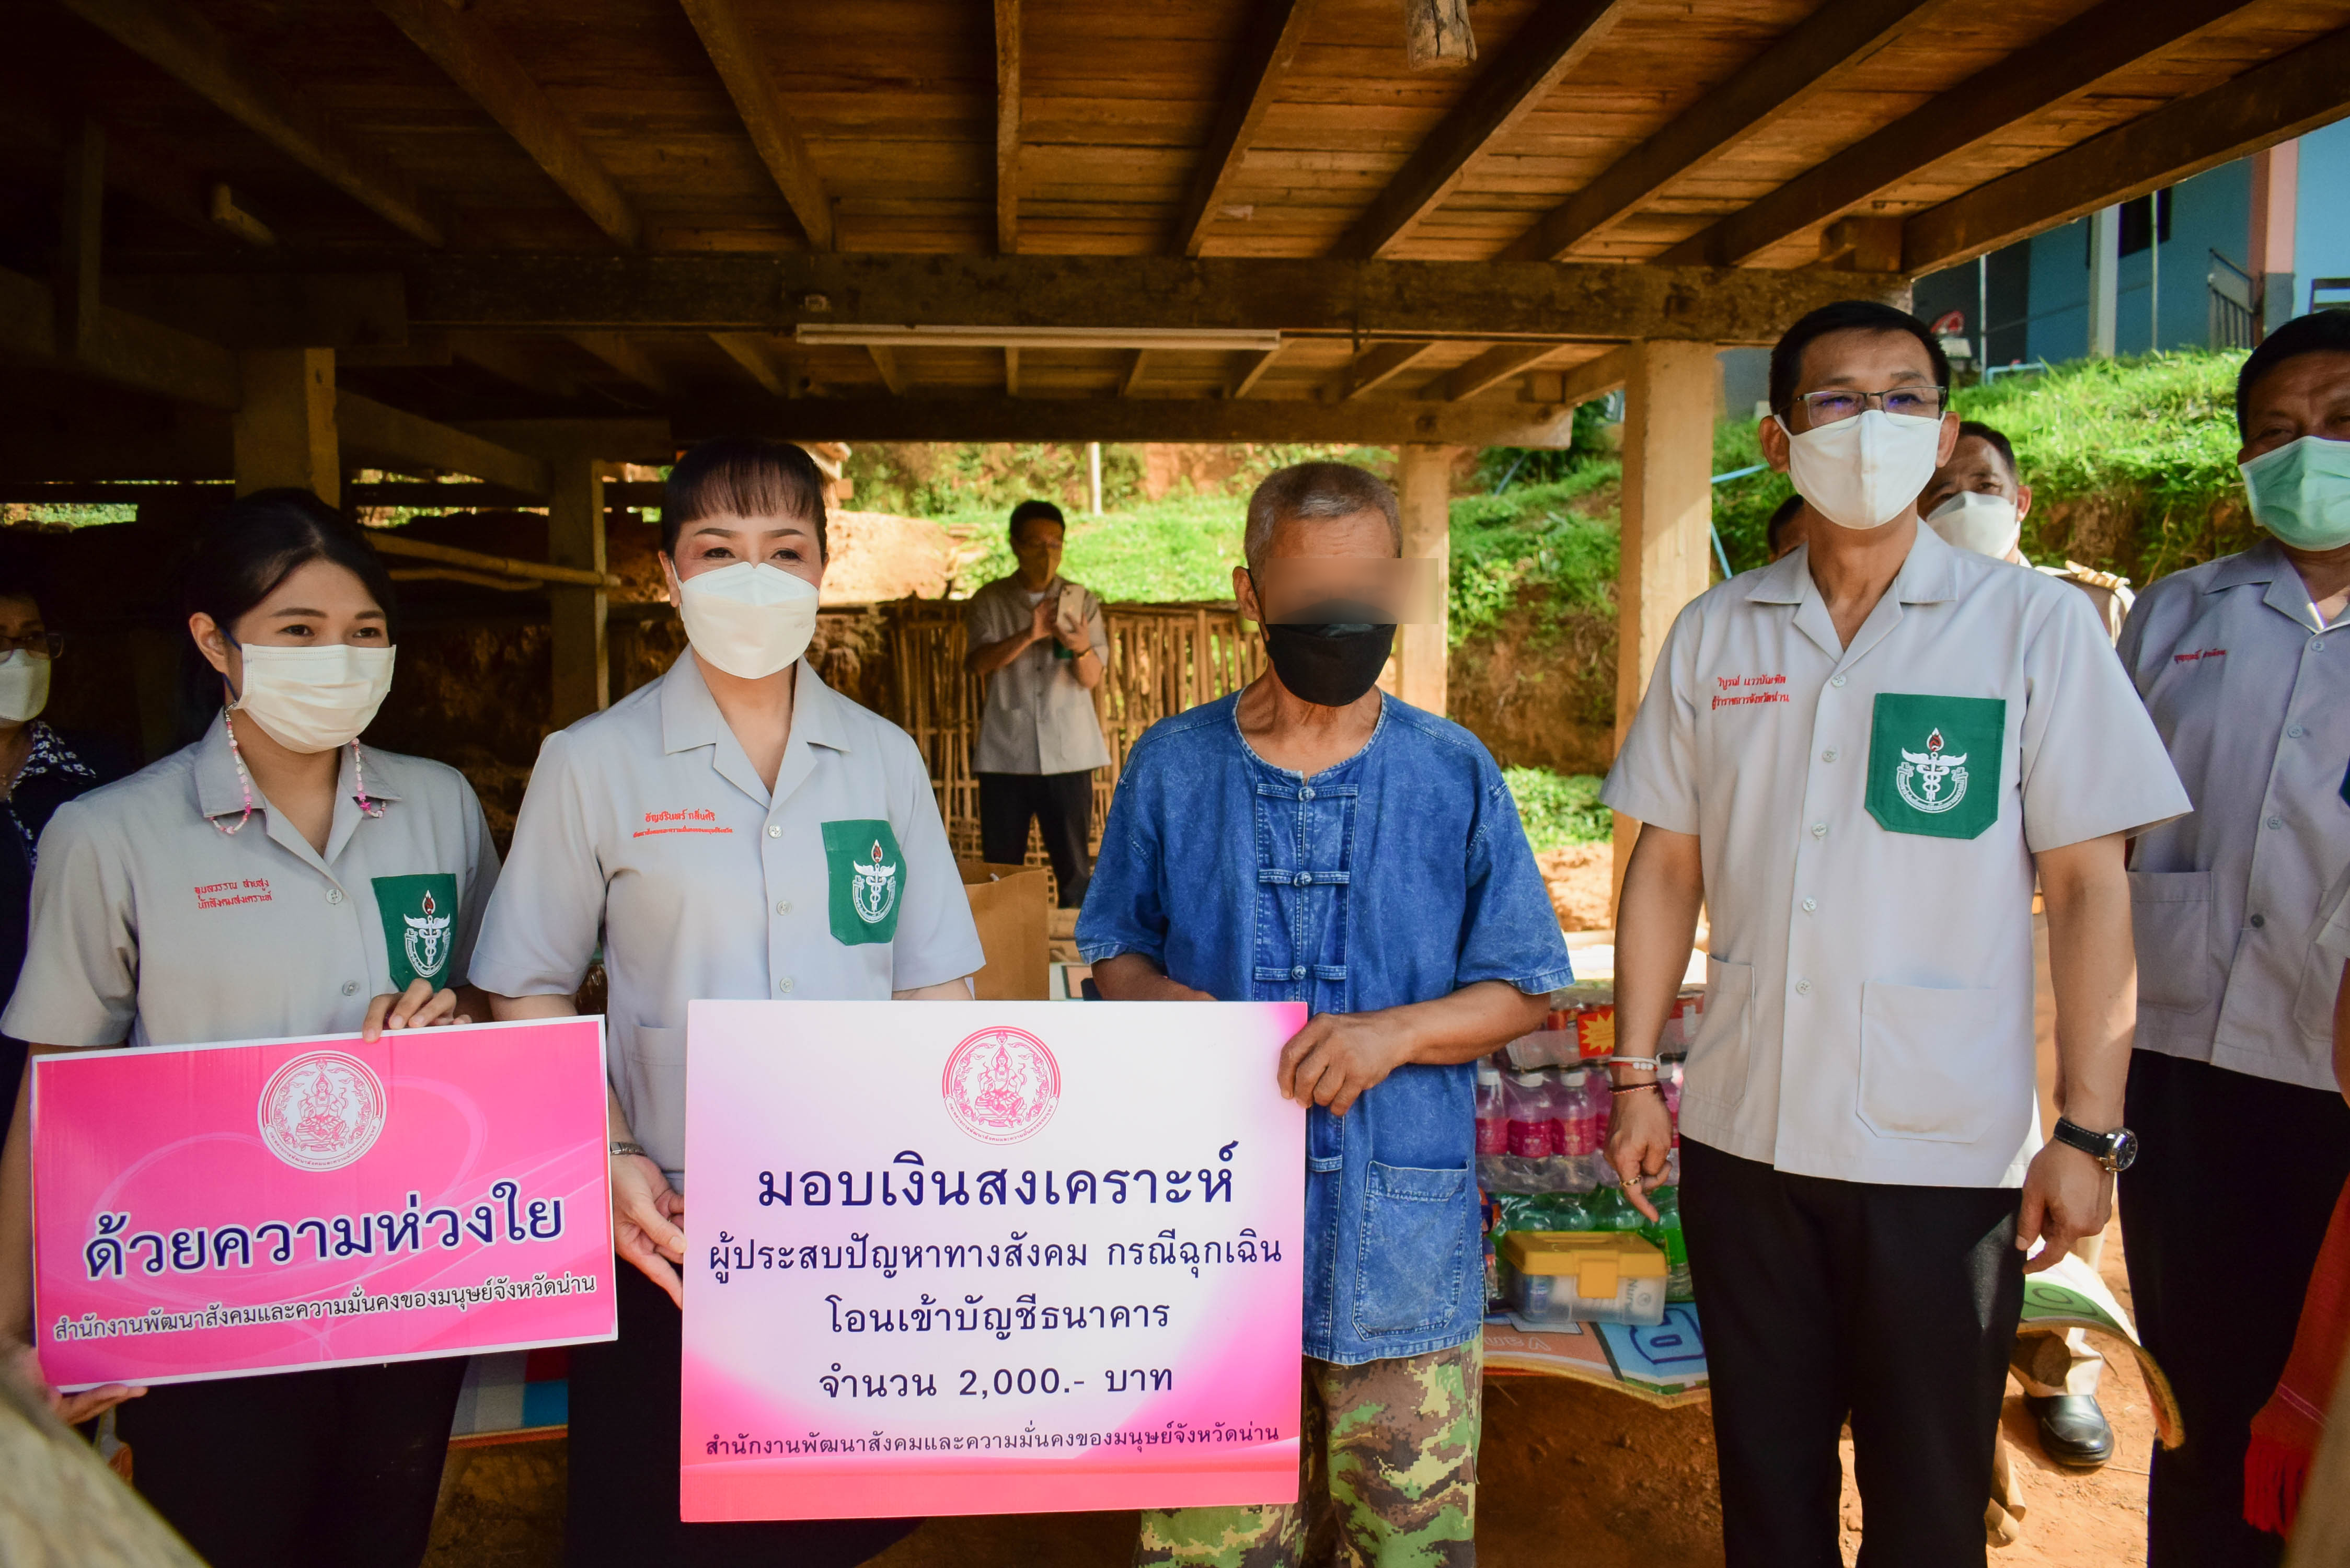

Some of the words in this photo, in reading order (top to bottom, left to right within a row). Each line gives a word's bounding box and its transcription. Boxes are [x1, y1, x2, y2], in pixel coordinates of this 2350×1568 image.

[758, 1140, 1239, 1207] มอบเงินสงเคราะห์
[84, 1178, 565, 1279] ด้วยความห่วงใย
[709, 1231, 1088, 1284] ผู้ประสบปัญหาทางสังคม
[1107, 1228, 1282, 1278] กรณีฉุกเฉิน
[54, 1271, 598, 1342] สำนักงานพัฒนาสังคมและความมั่นคงของมนุษย์จังหวัดน่าน
[824, 1293, 1171, 1341] โอนเข้าบัญชีธนาคาร
[819, 1362, 938, 1399] จำนวน
[959, 1368, 1085, 1400] 2,000.-
[1104, 1368, 1173, 1393] บาท
[705, 1420, 1280, 1455] สำนักงานพัฒนาสังคมและความมั่นคงของมนุษย์จังหวัดน่าน
